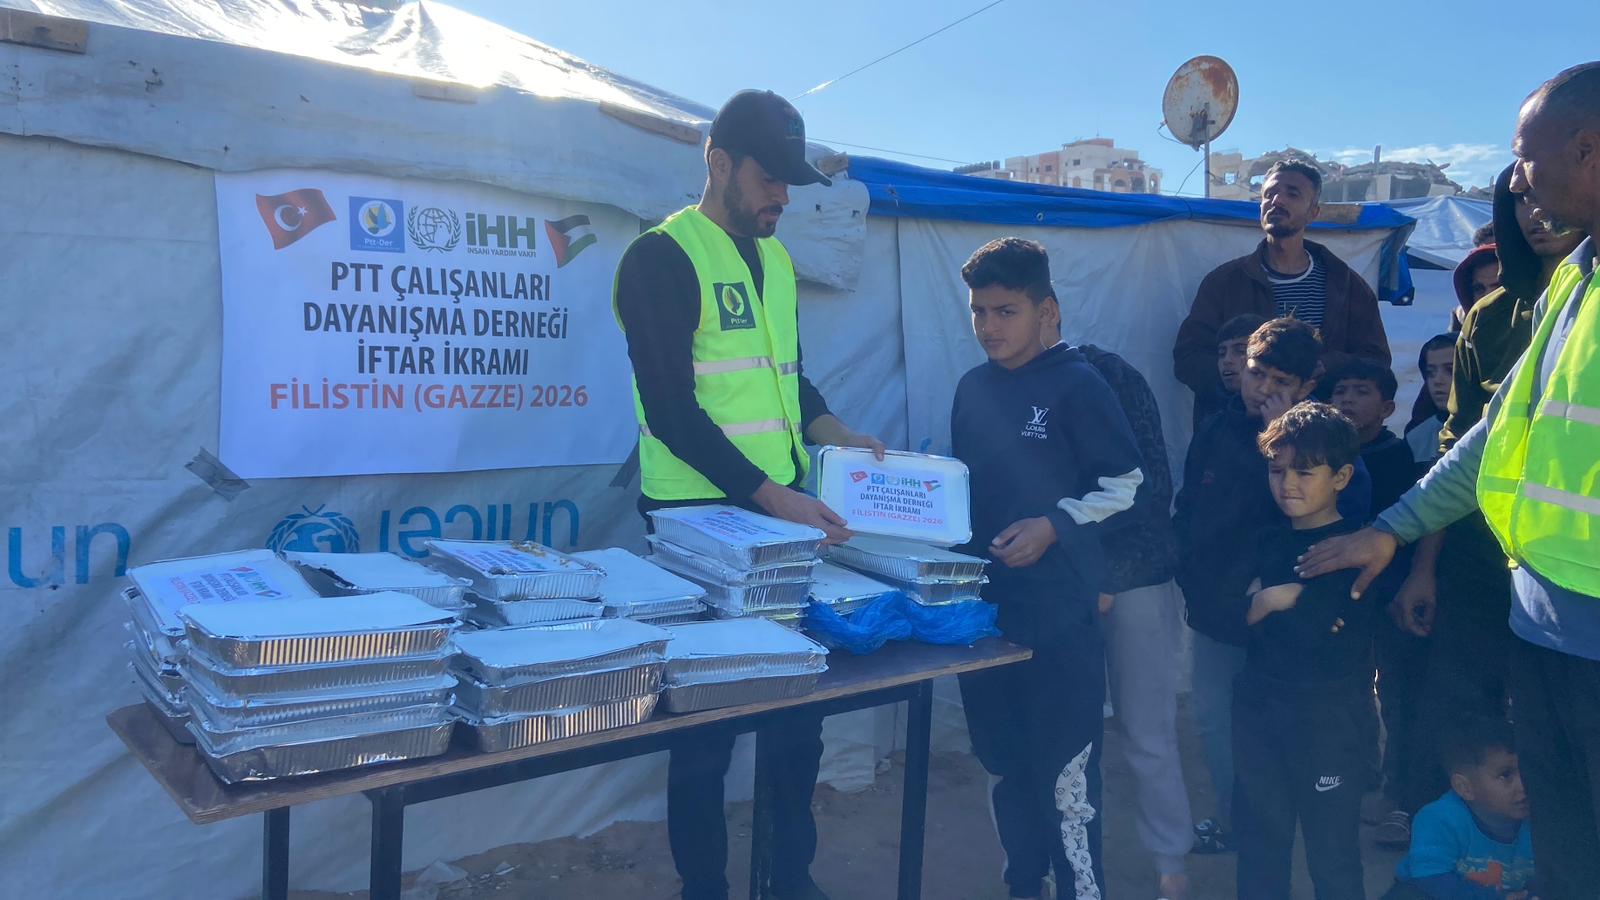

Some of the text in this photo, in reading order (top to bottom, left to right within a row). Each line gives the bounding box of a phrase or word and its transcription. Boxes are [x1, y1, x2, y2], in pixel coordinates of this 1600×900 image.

[331, 261, 551, 304] PTT ÇALIŞANLARI
[303, 301, 568, 342] DAYANIŞMA DERNEĞİ
[358, 338, 529, 376] İFTAR İKRAMI
[270, 377, 589, 413] FİLİSTİN (GAZZE) 2026
[1021, 430, 1048, 439] VUITTON
[1025, 424, 1046, 432] LOUIS
[860, 493, 901, 504] DAYANIŞMA
[866, 485, 927, 499] PTT ÇALIŞANLARI
[1319, 775, 1342, 785] NIKE
